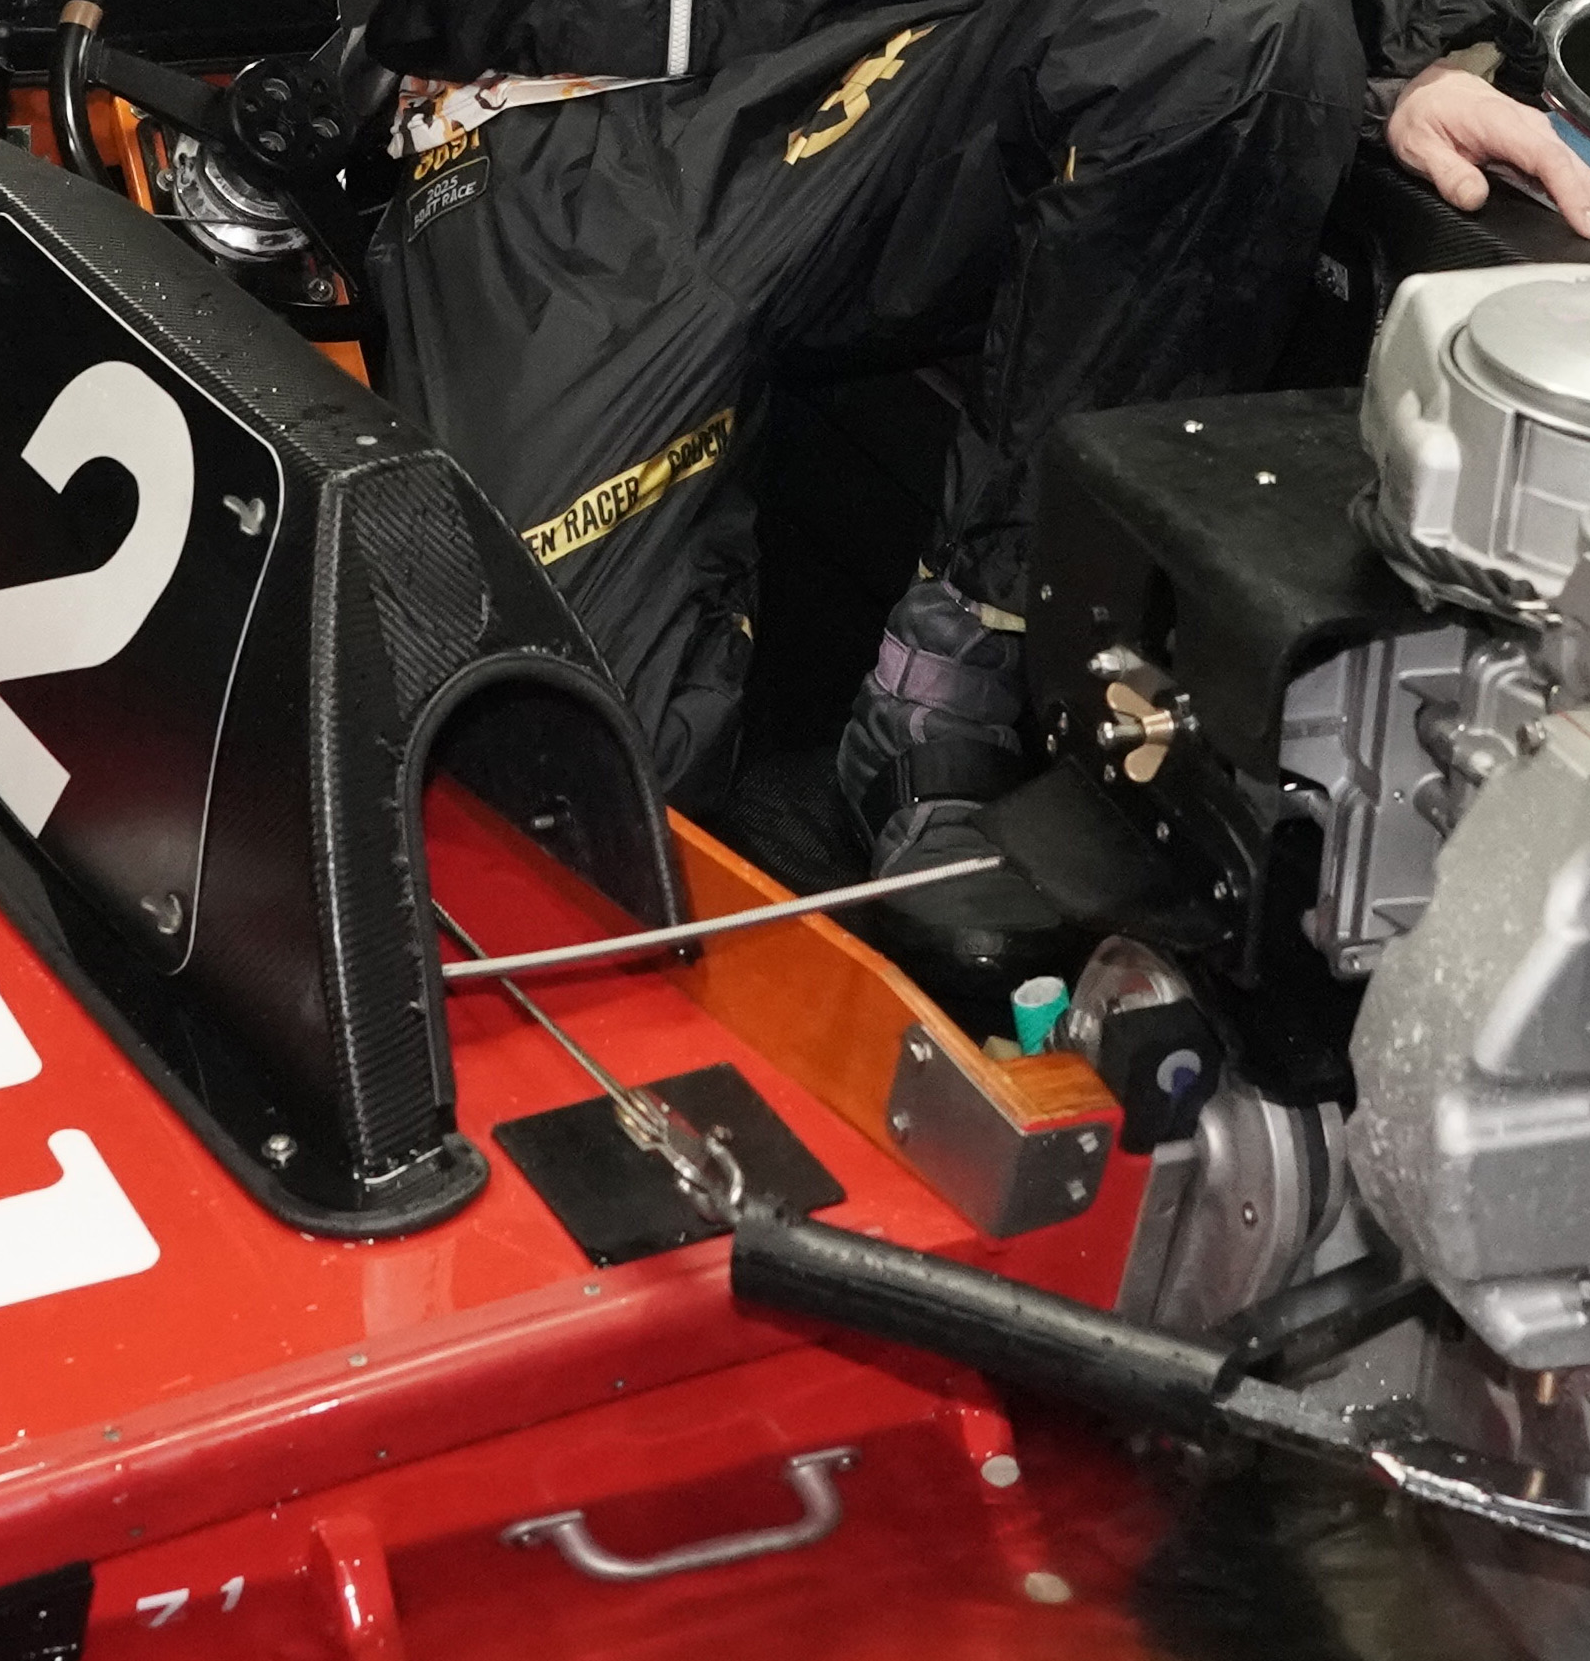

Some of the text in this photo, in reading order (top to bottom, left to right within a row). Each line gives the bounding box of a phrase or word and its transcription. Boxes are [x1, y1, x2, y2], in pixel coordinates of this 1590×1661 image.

[414, 181, 477, 230] BOAT RACE
[426, 174, 459, 203] 2025
[563, 476, 640, 543] RACER
[135, 1575, 245, 1629] 71
